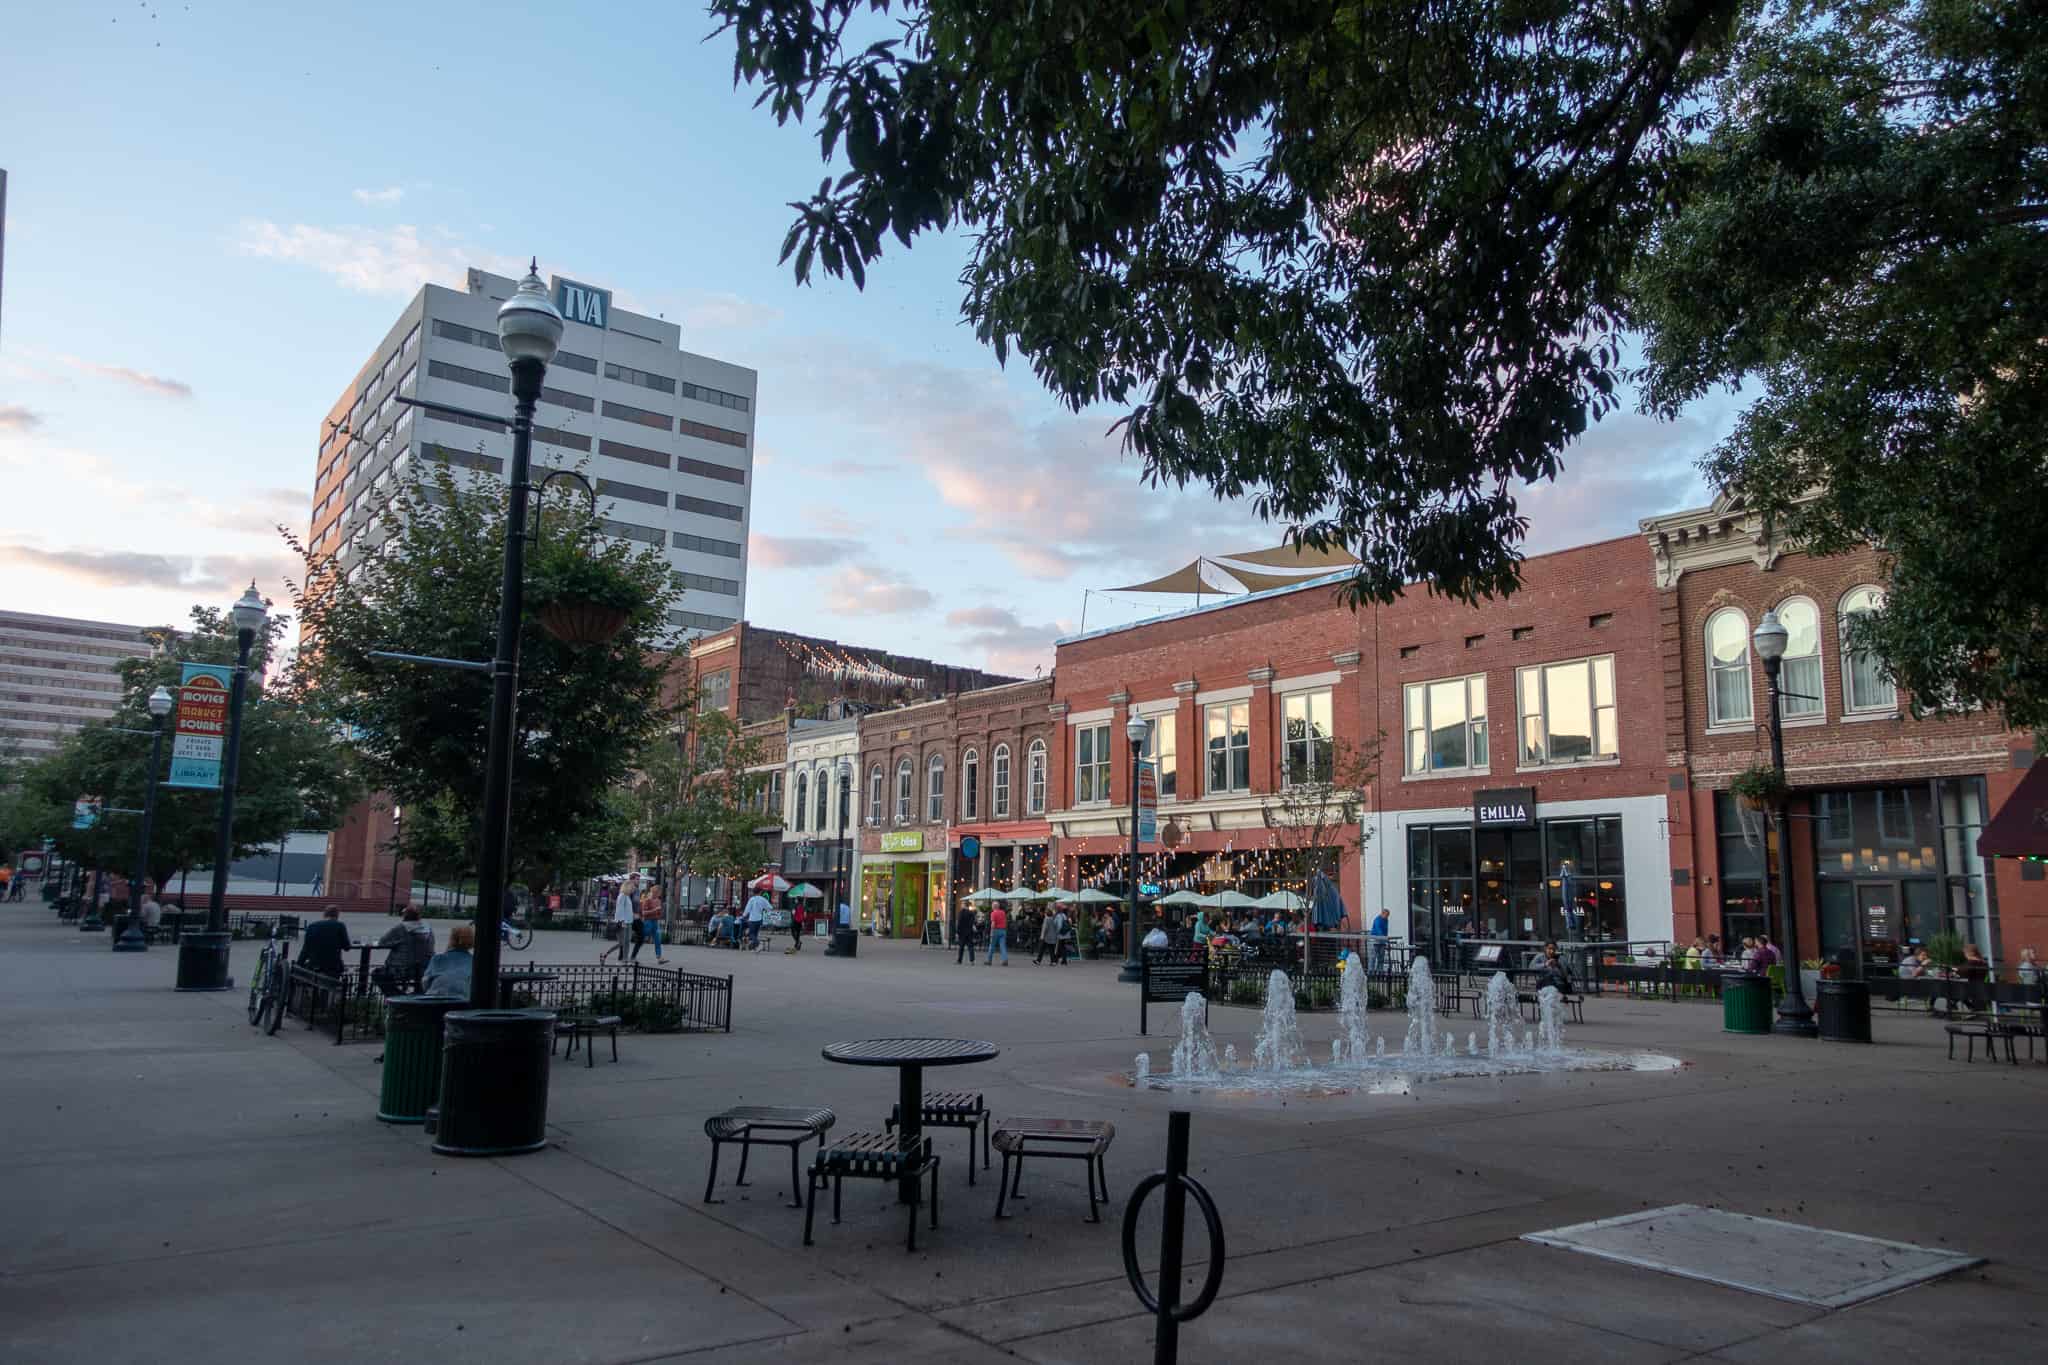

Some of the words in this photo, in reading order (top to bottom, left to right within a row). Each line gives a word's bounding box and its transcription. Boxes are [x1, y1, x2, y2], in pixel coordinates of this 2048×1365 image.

[564, 285, 602, 326] TVA
[183, 691, 225, 704] MOVIES
[181, 706, 224, 719] MARKET
[180, 719, 224, 731] SQUARE
[1480, 804, 1526, 820] EMILIA
[1442, 905, 1464, 913] EMILIA
